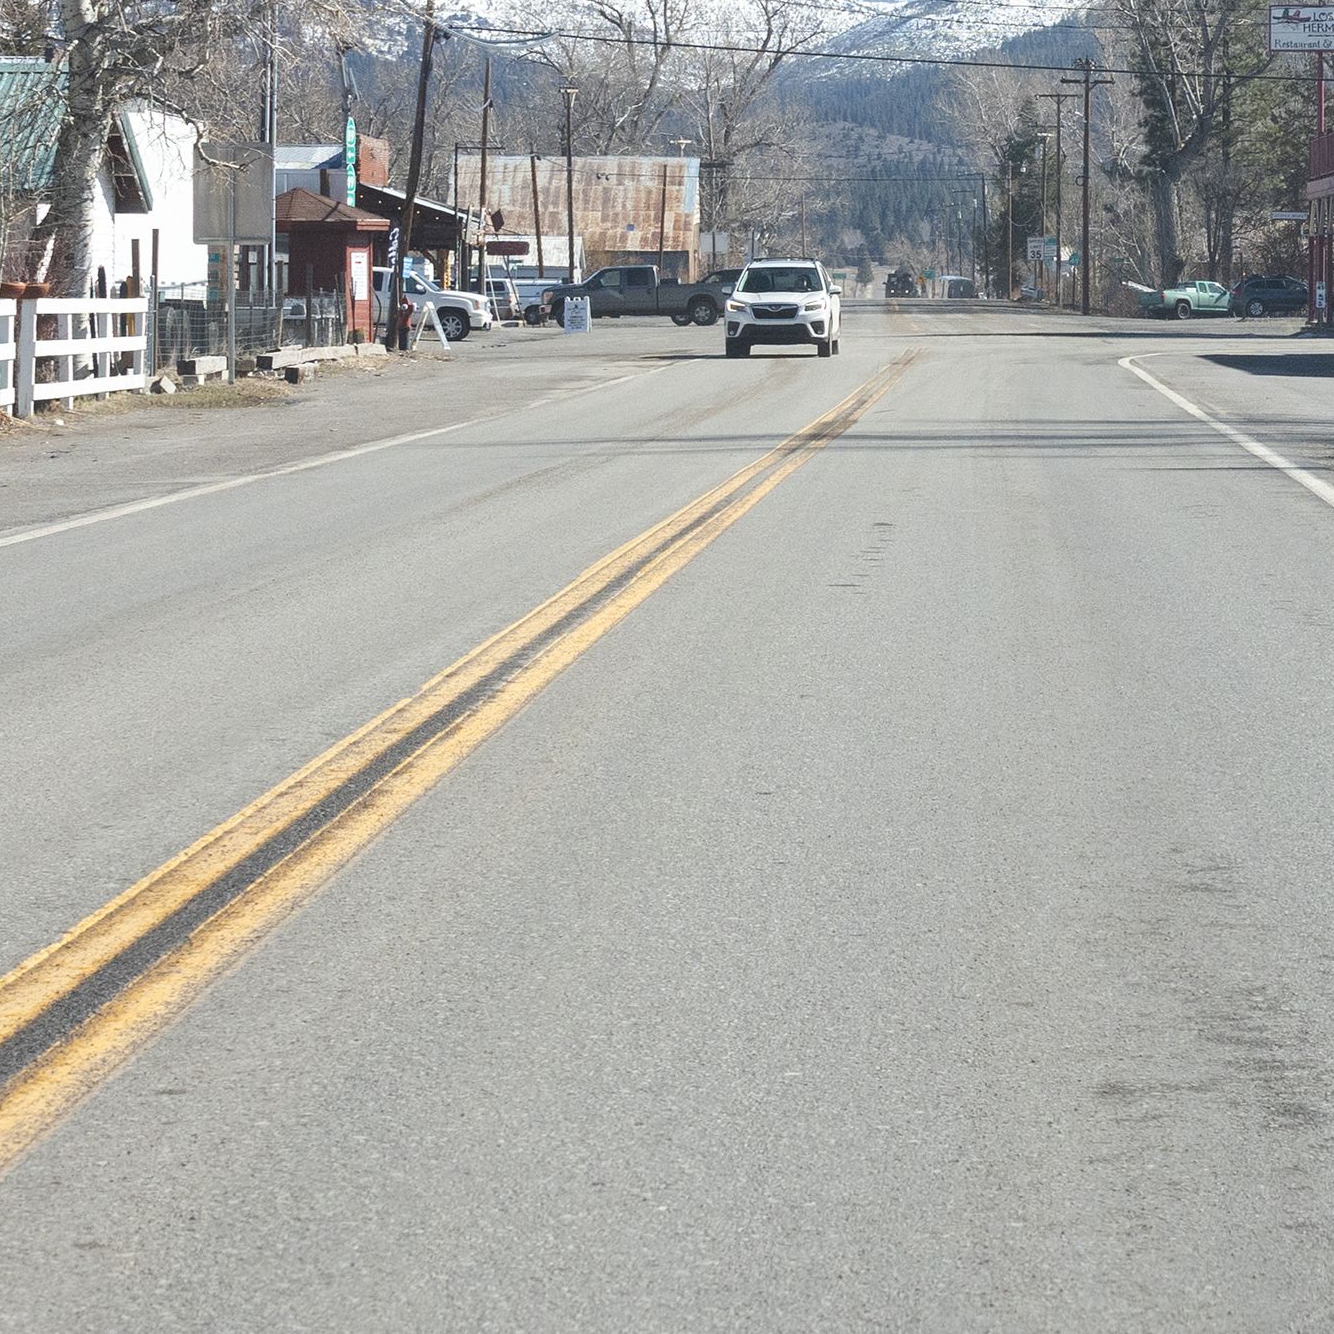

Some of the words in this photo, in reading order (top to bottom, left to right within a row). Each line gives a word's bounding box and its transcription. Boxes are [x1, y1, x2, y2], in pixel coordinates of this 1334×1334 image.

[1313, 12, 1333, 21] LOS
[1274, 39, 1320, 48] Restaurant
[1322, 39, 1331, 48] &
[1030, 250, 1042, 259] 35
